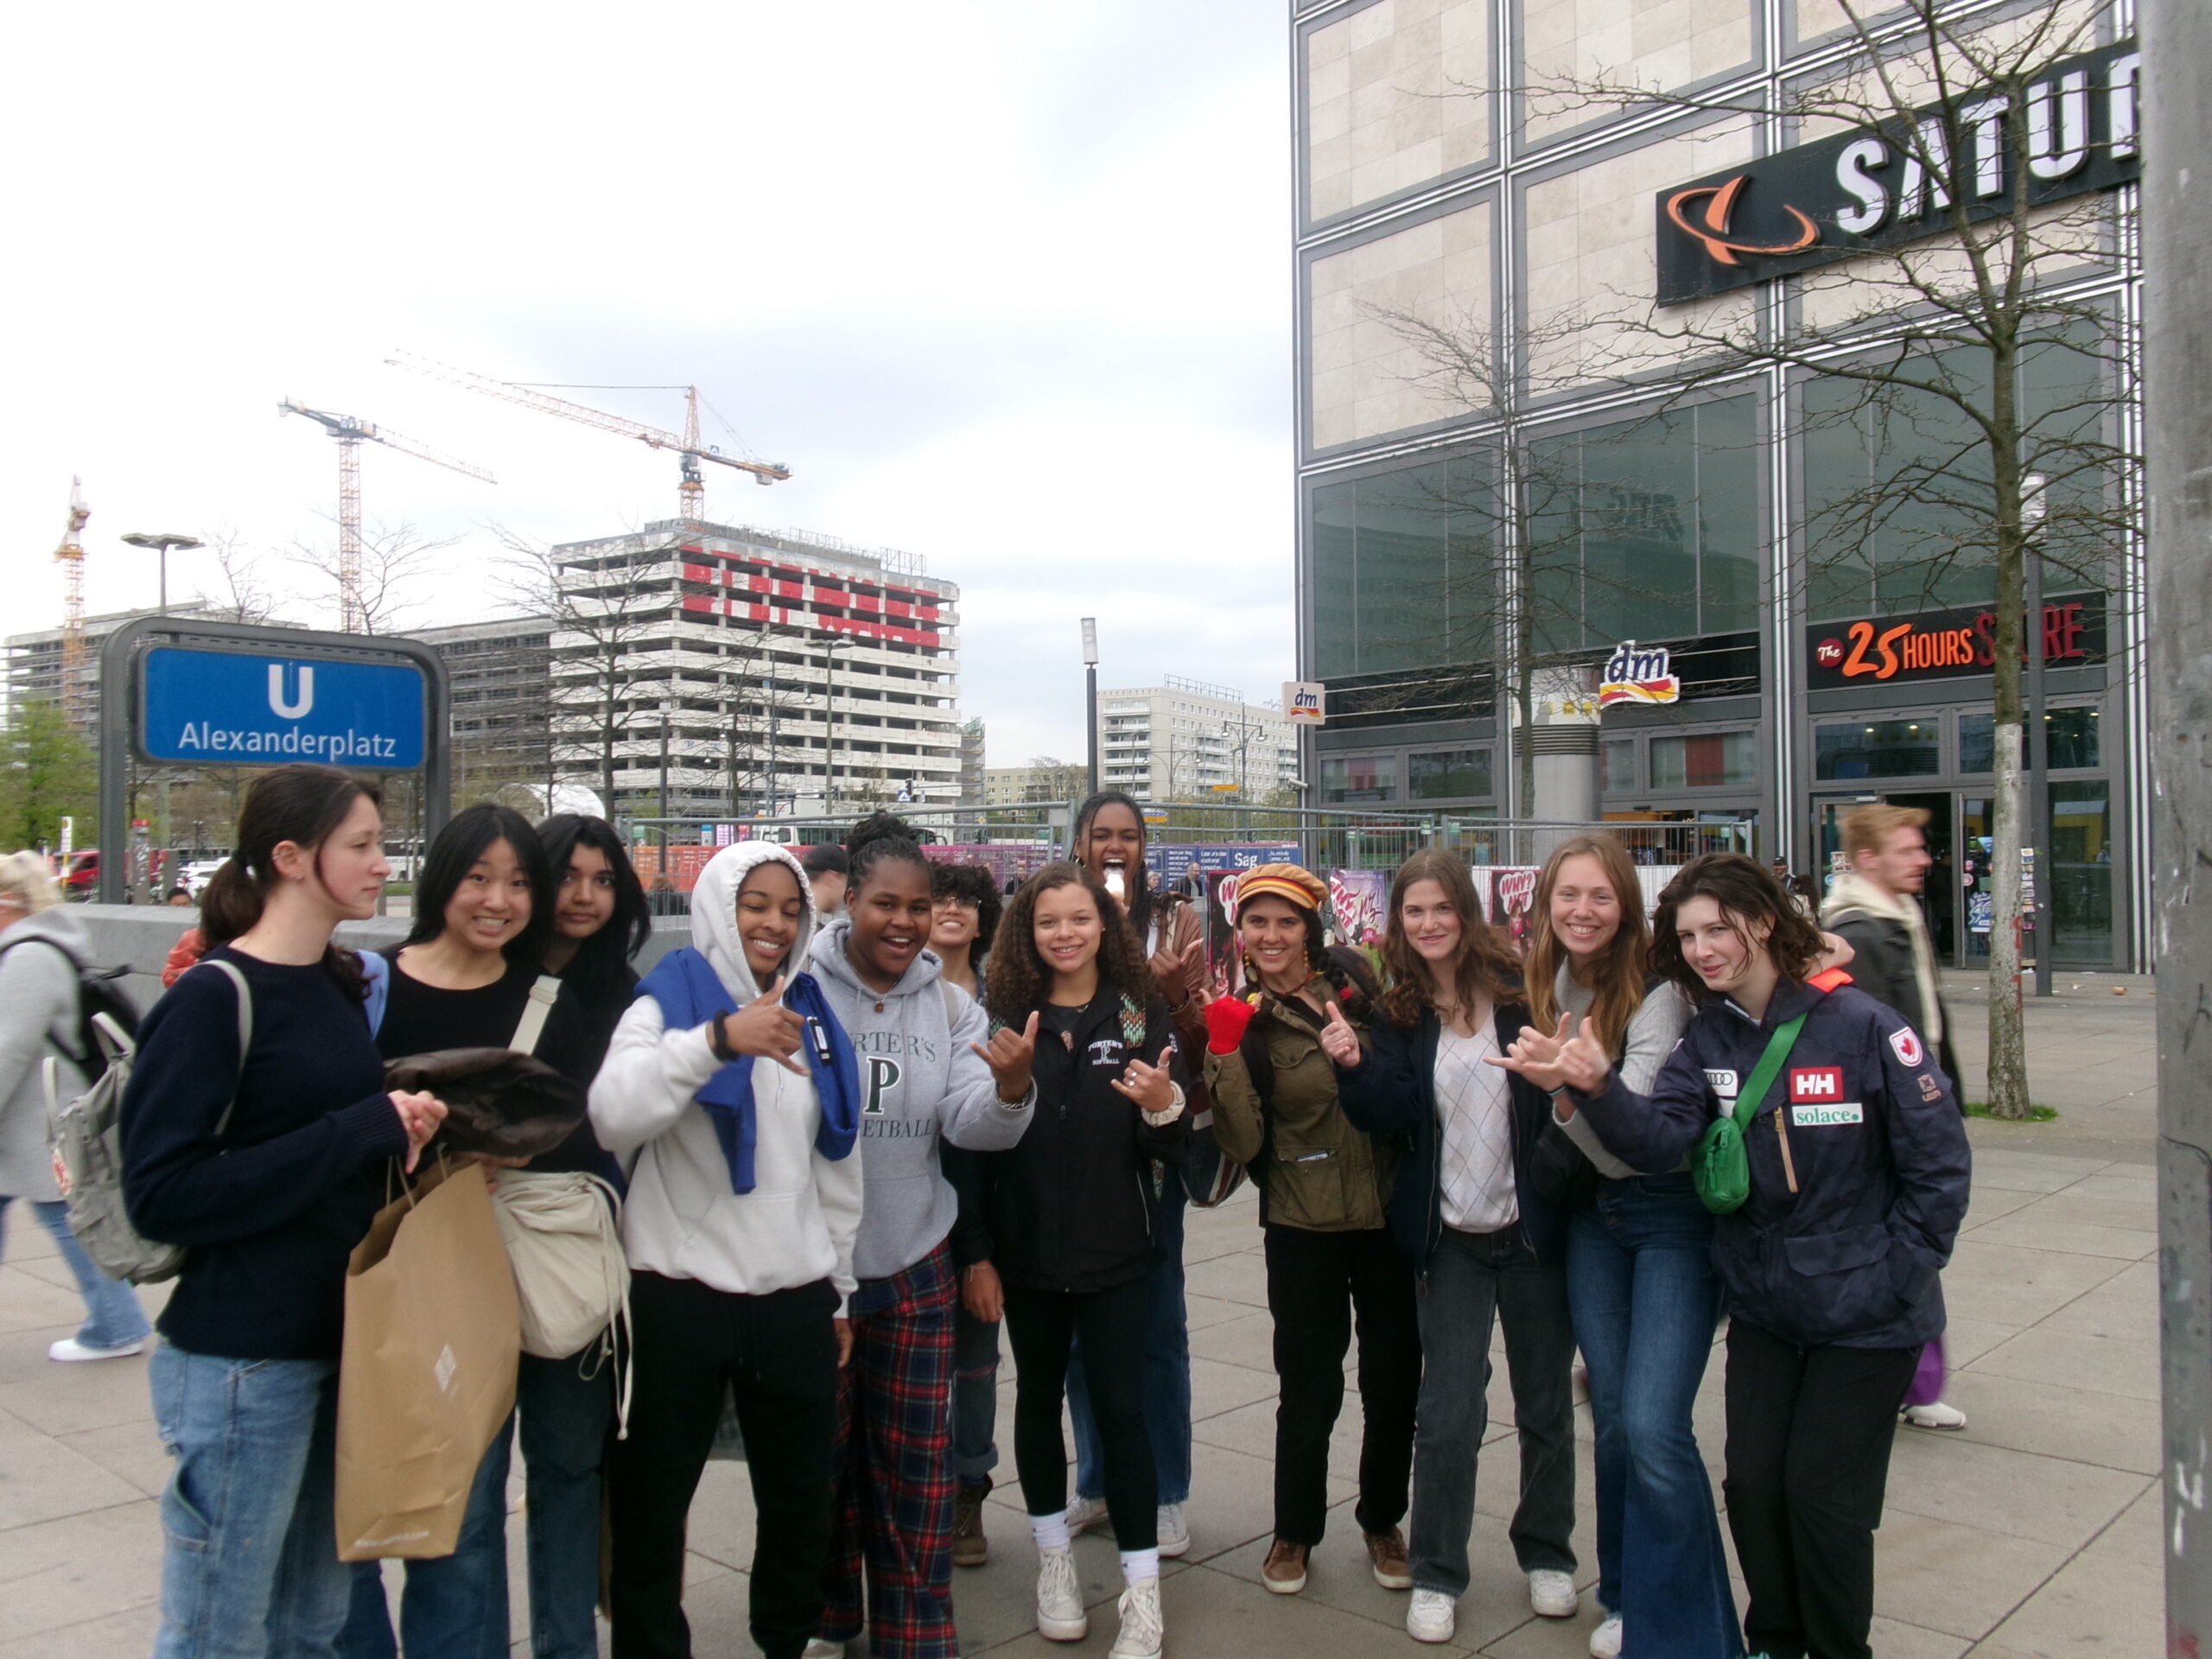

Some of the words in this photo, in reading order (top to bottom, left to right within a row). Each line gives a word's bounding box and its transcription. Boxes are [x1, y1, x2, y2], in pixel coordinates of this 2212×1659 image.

[1818, 644, 1841, 660] The
[1842, 621, 1913, 680] 25
[1904, 628, 1974, 670] HOURS
[1976, 602, 2085, 666] SRE
[1608, 645, 1666, 683] dm
[268, 664, 314, 720] U
[1294, 688, 1319, 708] dm
[178, 721, 397, 762] Alexanderplatz
[1234, 852, 1258, 870] Sag
[1502, 873, 1532, 896] WHY?
[852, 1031, 936, 1063] RTER'S
[863, 1056, 901, 1115] P
[1796, 1073, 1834, 1095] HH
[863, 1118, 932, 1138] ETBALL
